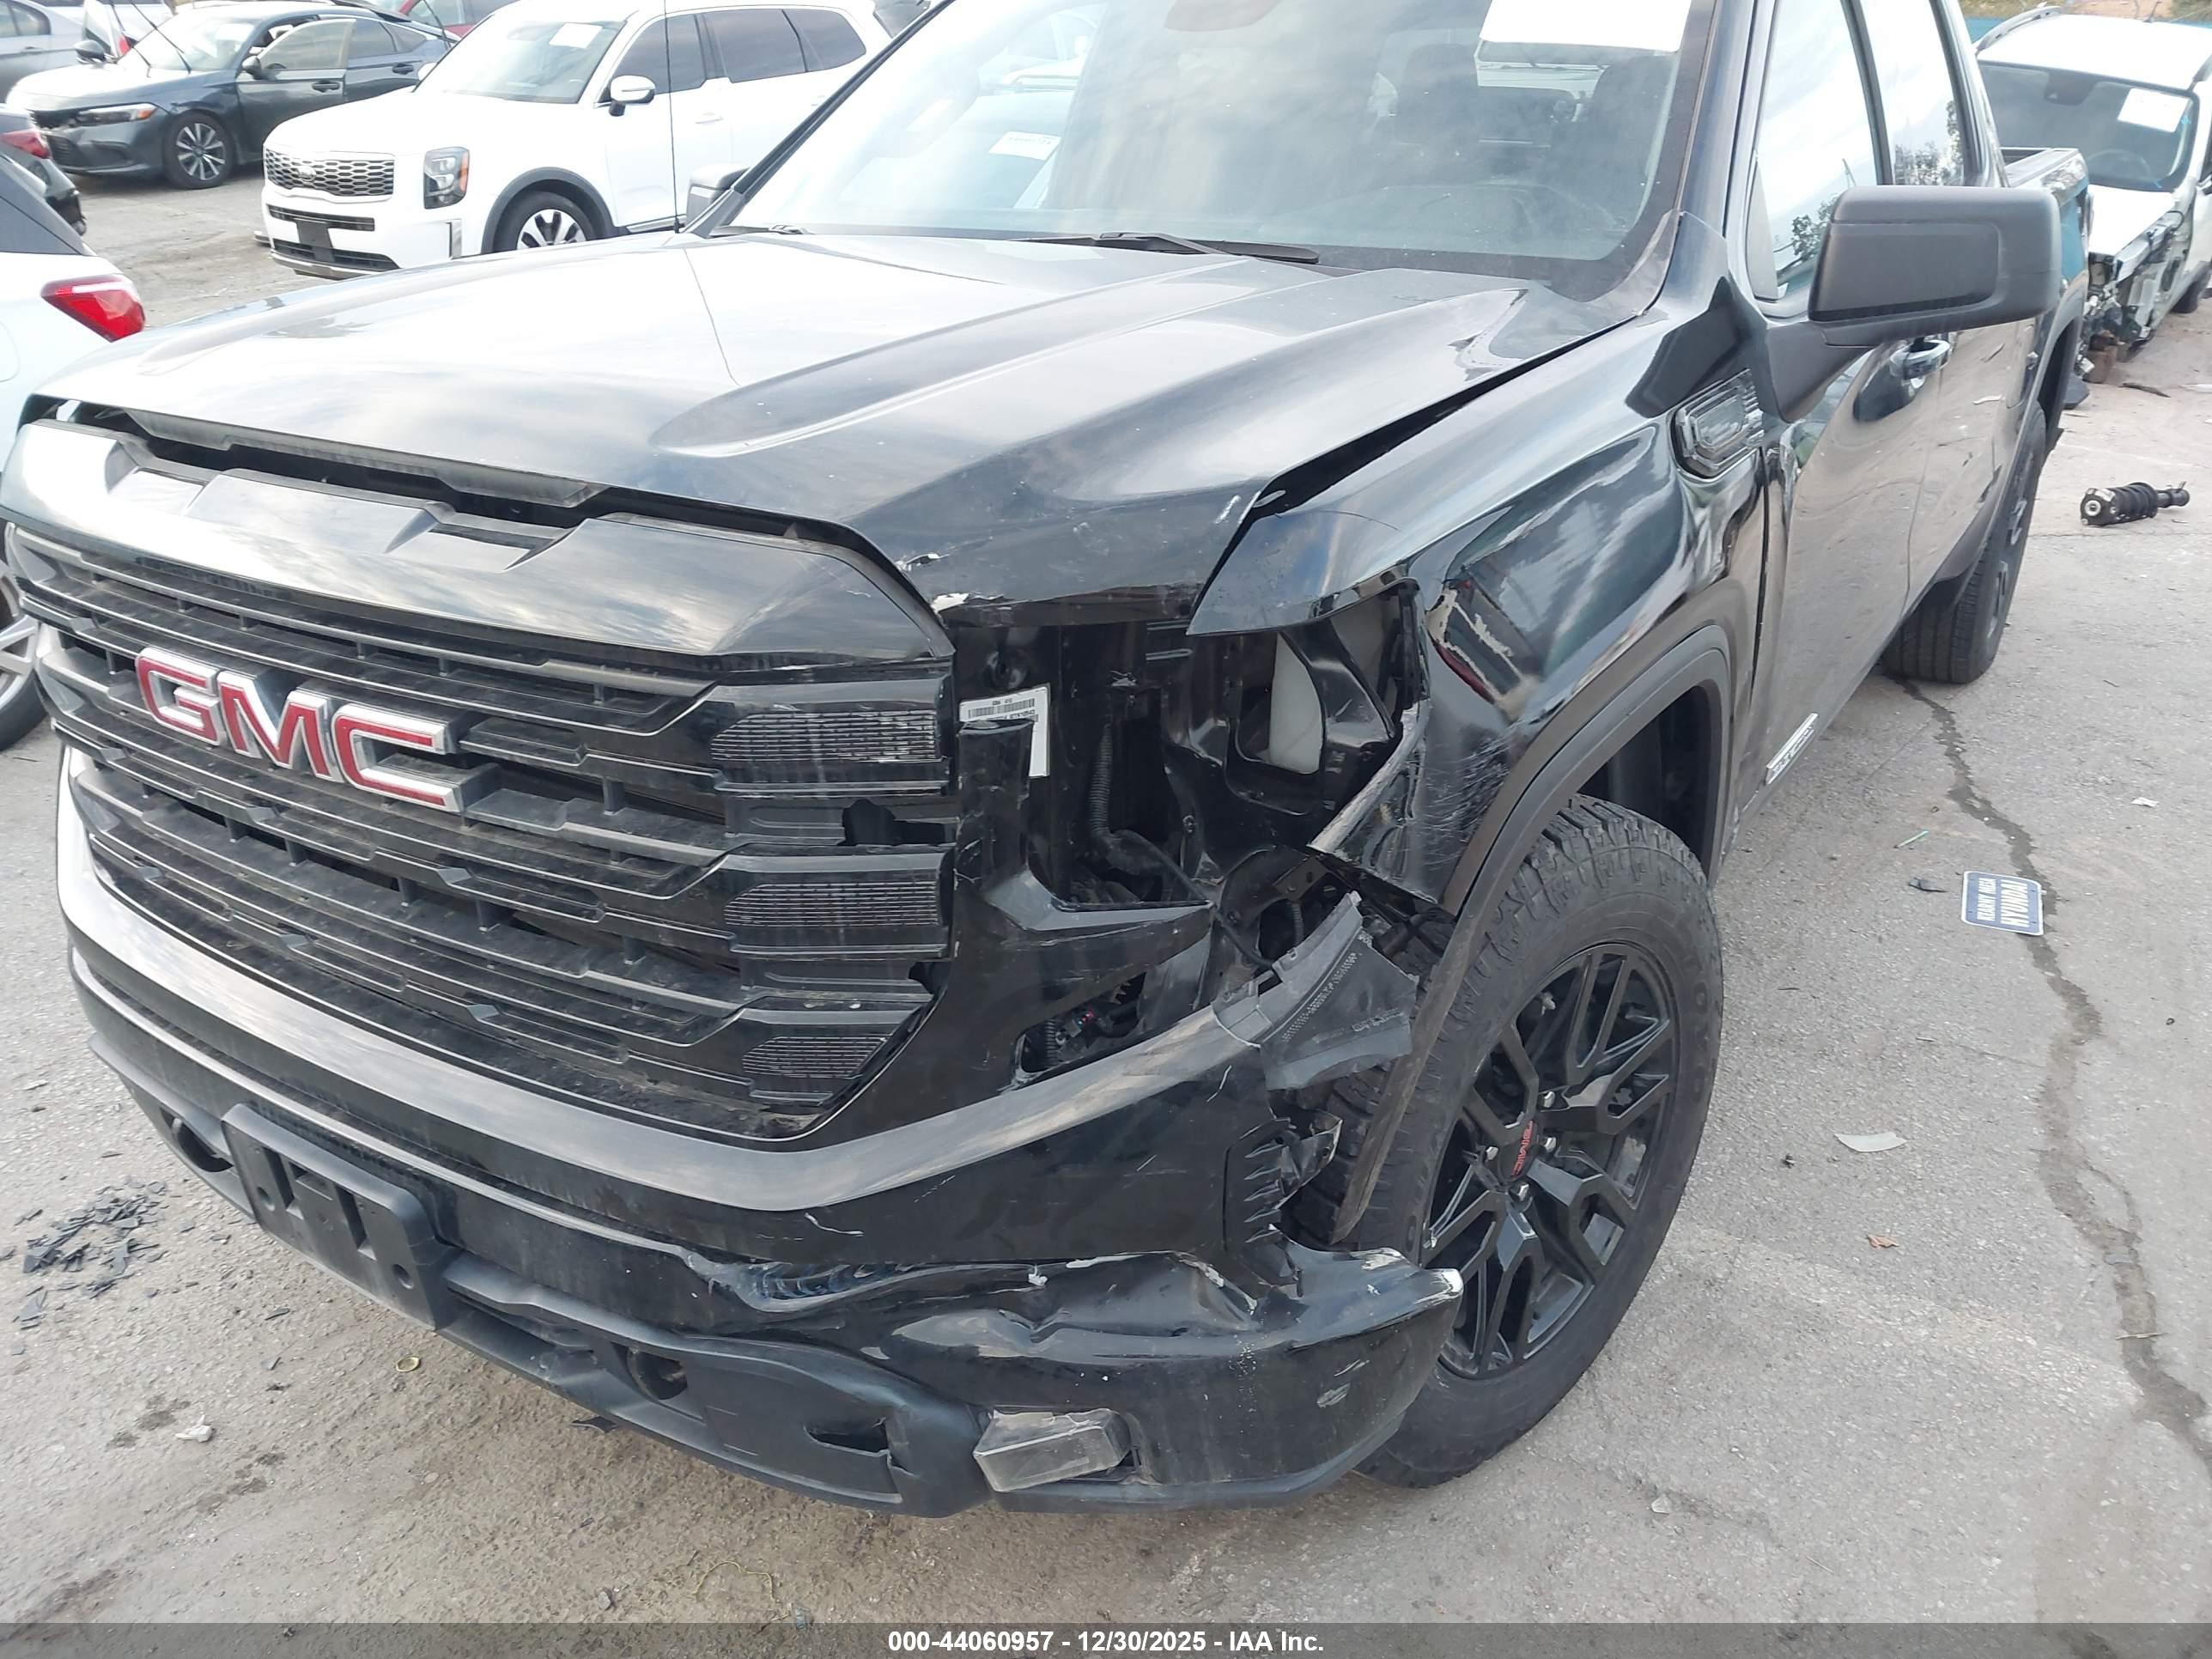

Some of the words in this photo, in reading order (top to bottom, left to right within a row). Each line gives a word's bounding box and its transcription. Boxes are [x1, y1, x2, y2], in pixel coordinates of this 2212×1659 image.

[135, 647, 463, 812] GMC
[1978, 878, 1996, 895] MESA
[1999, 878, 2030, 928] HYUNDAI
[1977, 893, 1996, 921] KEARNY
